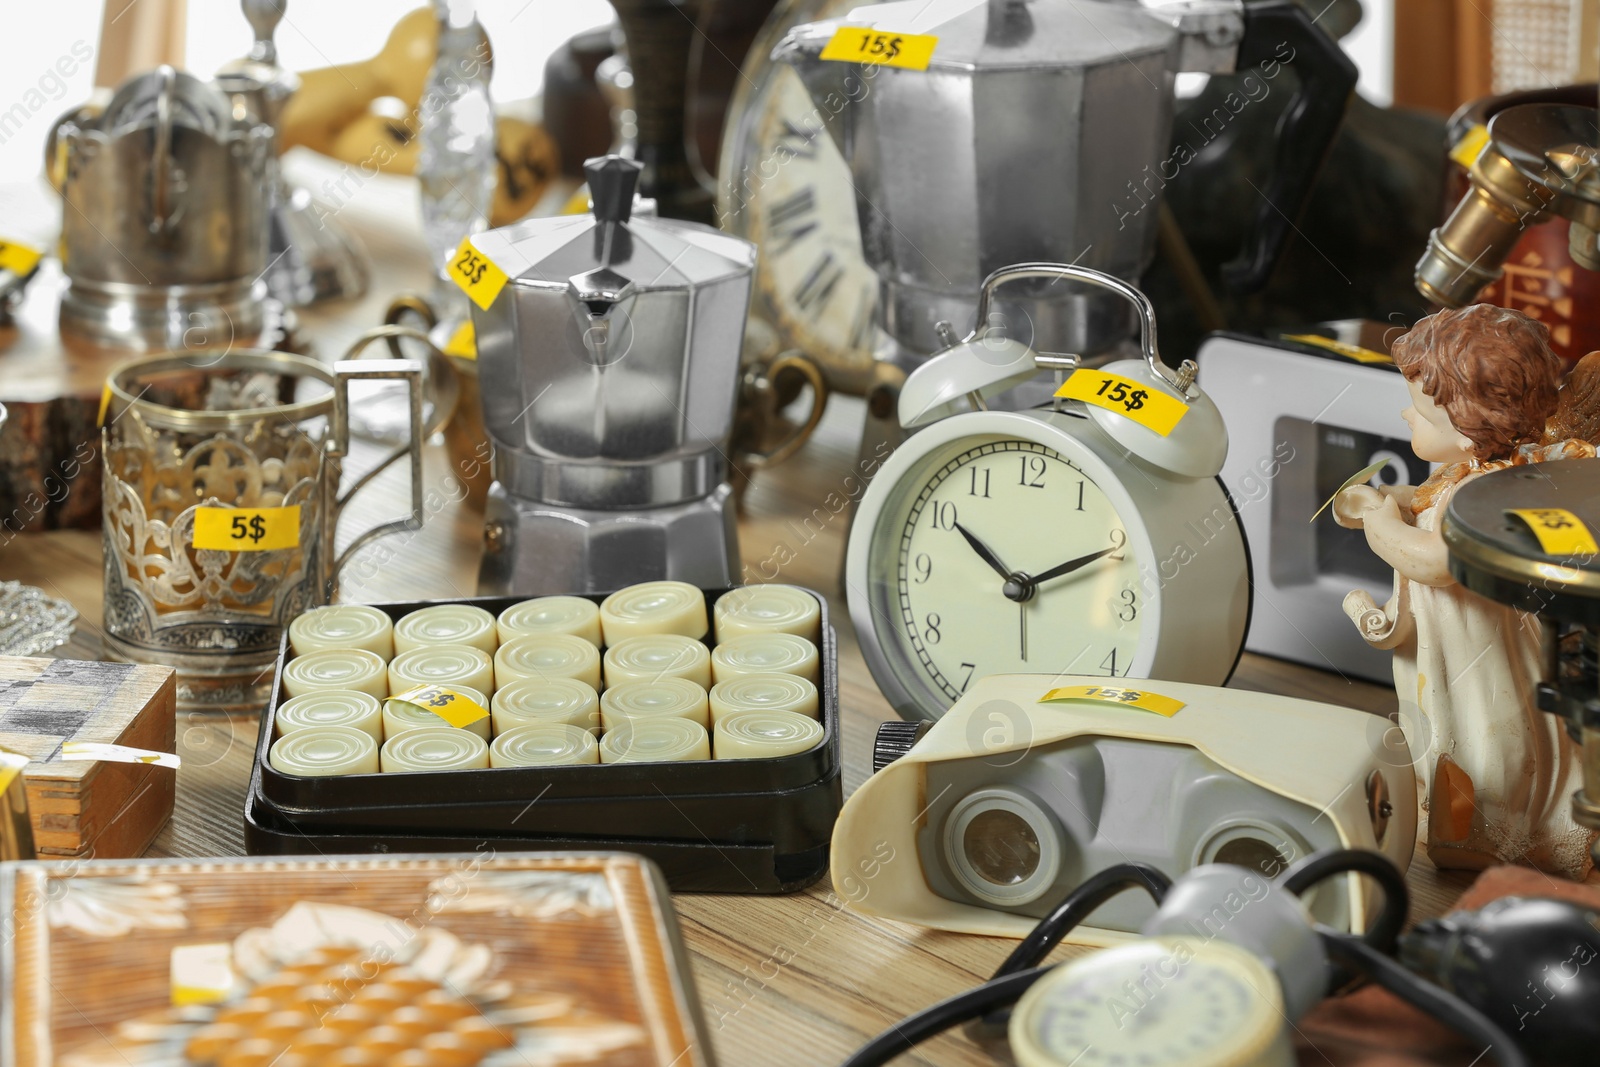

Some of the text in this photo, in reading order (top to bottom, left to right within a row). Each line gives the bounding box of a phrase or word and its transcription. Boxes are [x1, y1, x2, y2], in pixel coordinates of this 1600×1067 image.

[859, 34, 904, 59] 15$
[456, 250, 487, 286] 25$
[1096, 379, 1149, 412] 15$
[968, 466, 992, 499] 11
[1017, 455, 1047, 488] 12
[1075, 480, 1086, 512] 1
[230, 514, 266, 545] 5$
[930, 500, 958, 532] 10
[1107, 528, 1127, 561] 2
[914, 553, 932, 584] 9
[1119, 589, 1138, 622] 3
[924, 612, 941, 645] 8
[960, 662, 976, 693] 7
[1099, 647, 1120, 678] 4
[418, 690, 455, 707] 6$
[1085, 688, 1141, 702] 15$
